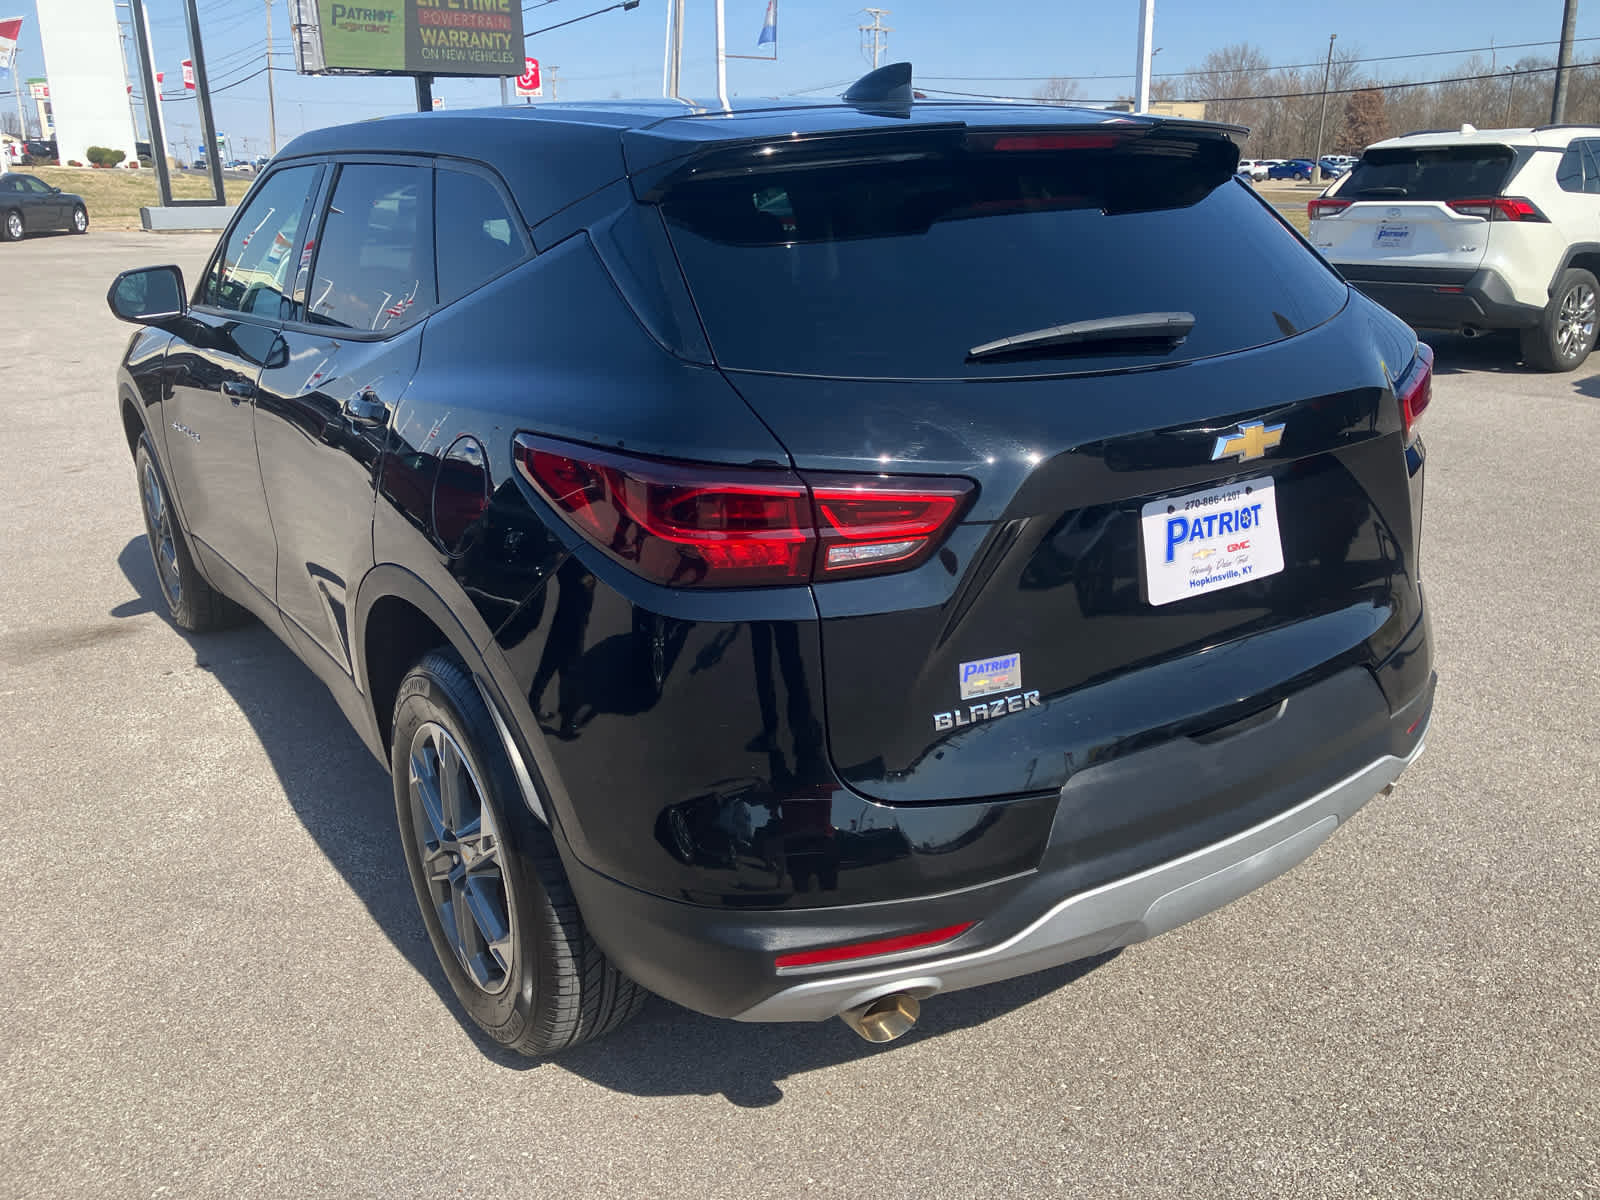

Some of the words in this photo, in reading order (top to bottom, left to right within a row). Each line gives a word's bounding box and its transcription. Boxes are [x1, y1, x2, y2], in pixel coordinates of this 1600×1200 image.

[331, 4, 394, 26] PATRIOT
[423, 11, 508, 29] POWERTRAIN
[420, 27, 512, 49] WARRANTY
[421, 47, 440, 60] ON
[441, 49, 466, 61] NEW
[467, 50, 515, 64] VEHICLES
[1165, 503, 1262, 563] PATRIOT
[1227, 540, 1250, 552] GMC
[1189, 569, 1241, 588] Hopkinsville,
[1242, 564, 1253, 575] KY
[963, 656, 1018, 683] PATRIOT
[933, 690, 1041, 732] BLAZER
